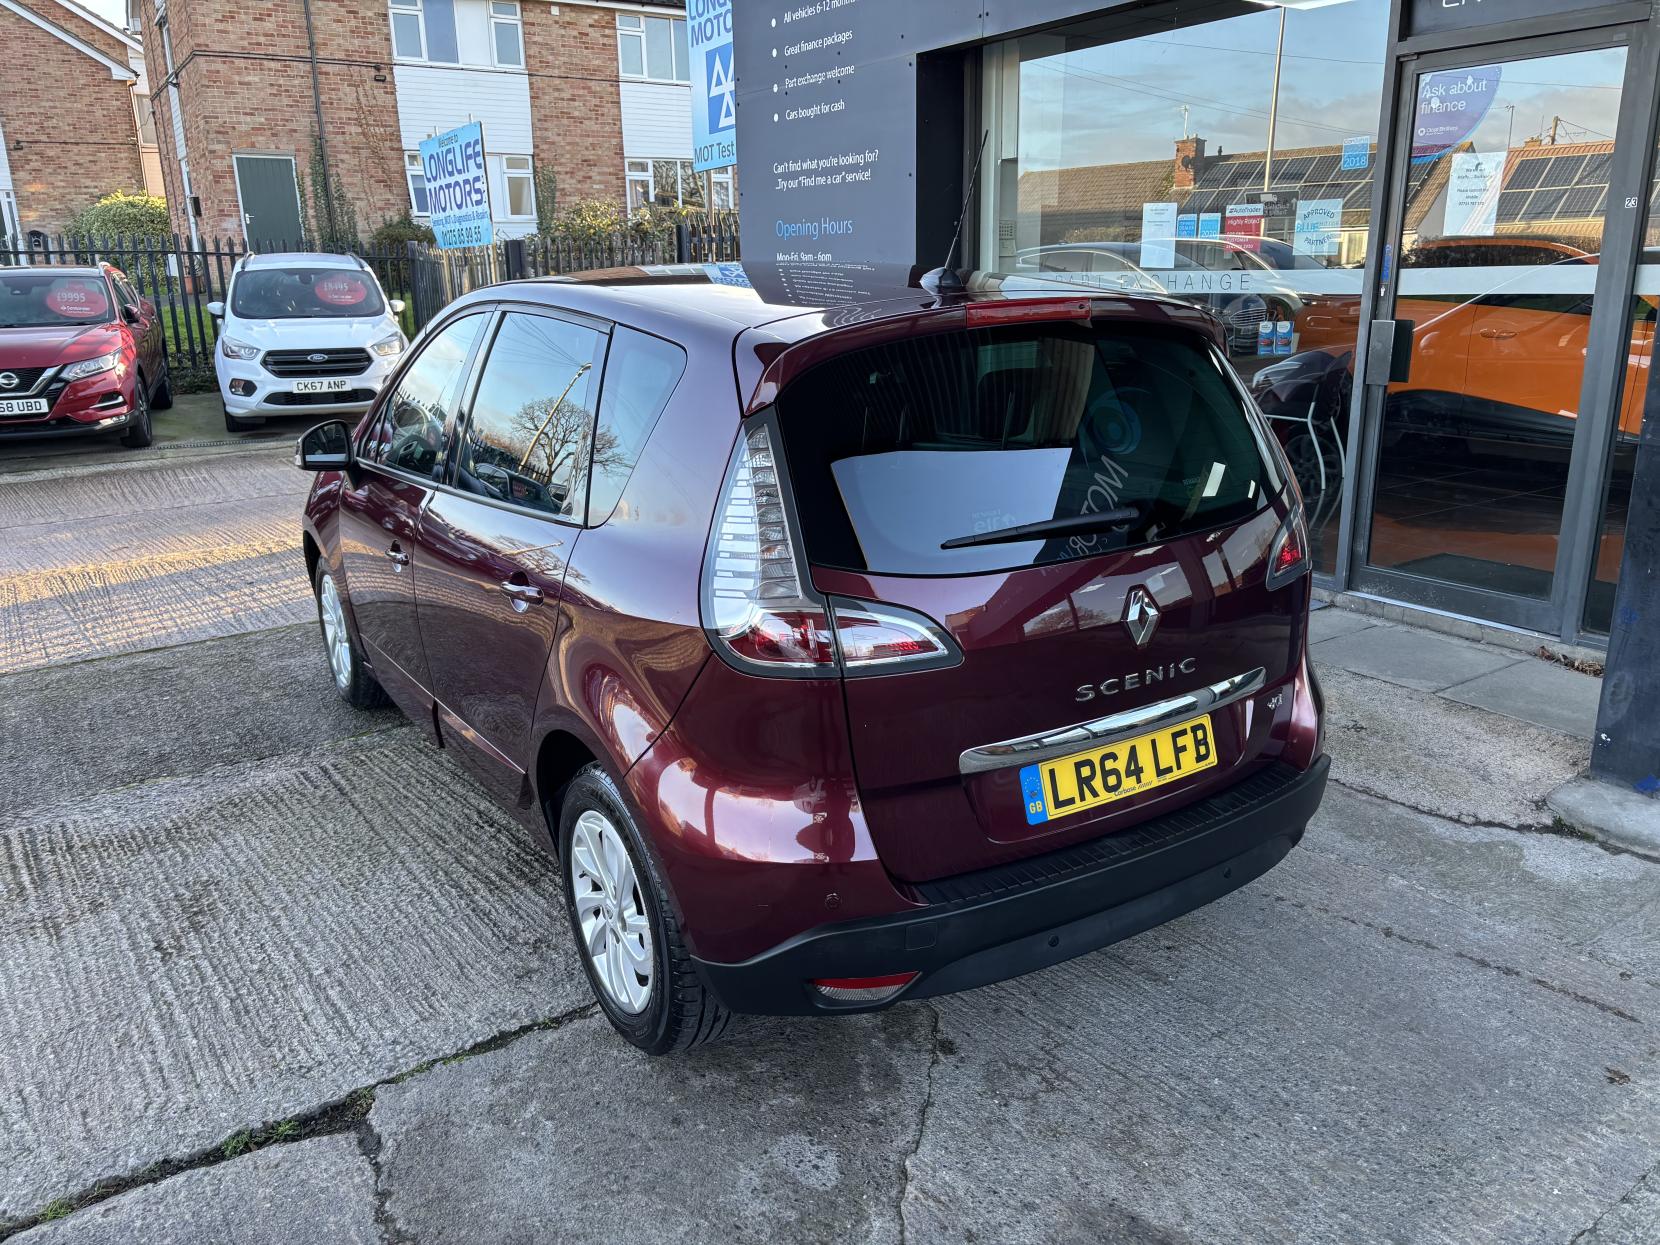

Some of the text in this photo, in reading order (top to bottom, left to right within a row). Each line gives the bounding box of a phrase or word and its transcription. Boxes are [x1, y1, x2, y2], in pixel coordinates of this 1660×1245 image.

[792, 6, 816, 21] vehicles
[816, 0, 830, 13] 6-12
[784, 30, 853, 57] Great finance packages
[785, 65, 855, 88] Part exchange welcome
[1422, 76, 1488, 99] Ask about
[786, 99, 845, 120] Cars bought for cash
[422, 139, 482, 183] LONGLIFE
[694, 140, 735, 164] MOT Test
[773, 149, 879, 174] Can't find what you're looking for?
[1344, 156, 1366, 167] 2018
[788, 179, 798, 188] our
[815, 175, 826, 186] me
[846, 169, 871, 183] service!
[429, 176, 483, 215] MOTORS
[1624, 196, 1638, 208] 23
[1303, 208, 1335, 220] APPROVED
[776, 217, 853, 240] Opening Hours
[1120, 273, 1251, 291] EXCHANGE
[296, 380, 346, 391] CK67 ANP
[17, 400, 41, 412] UBD
[1075, 657, 1196, 702] SCENIC
[1049, 722, 1211, 809] LR64 LFB
[1029, 801, 1043, 814] GB
